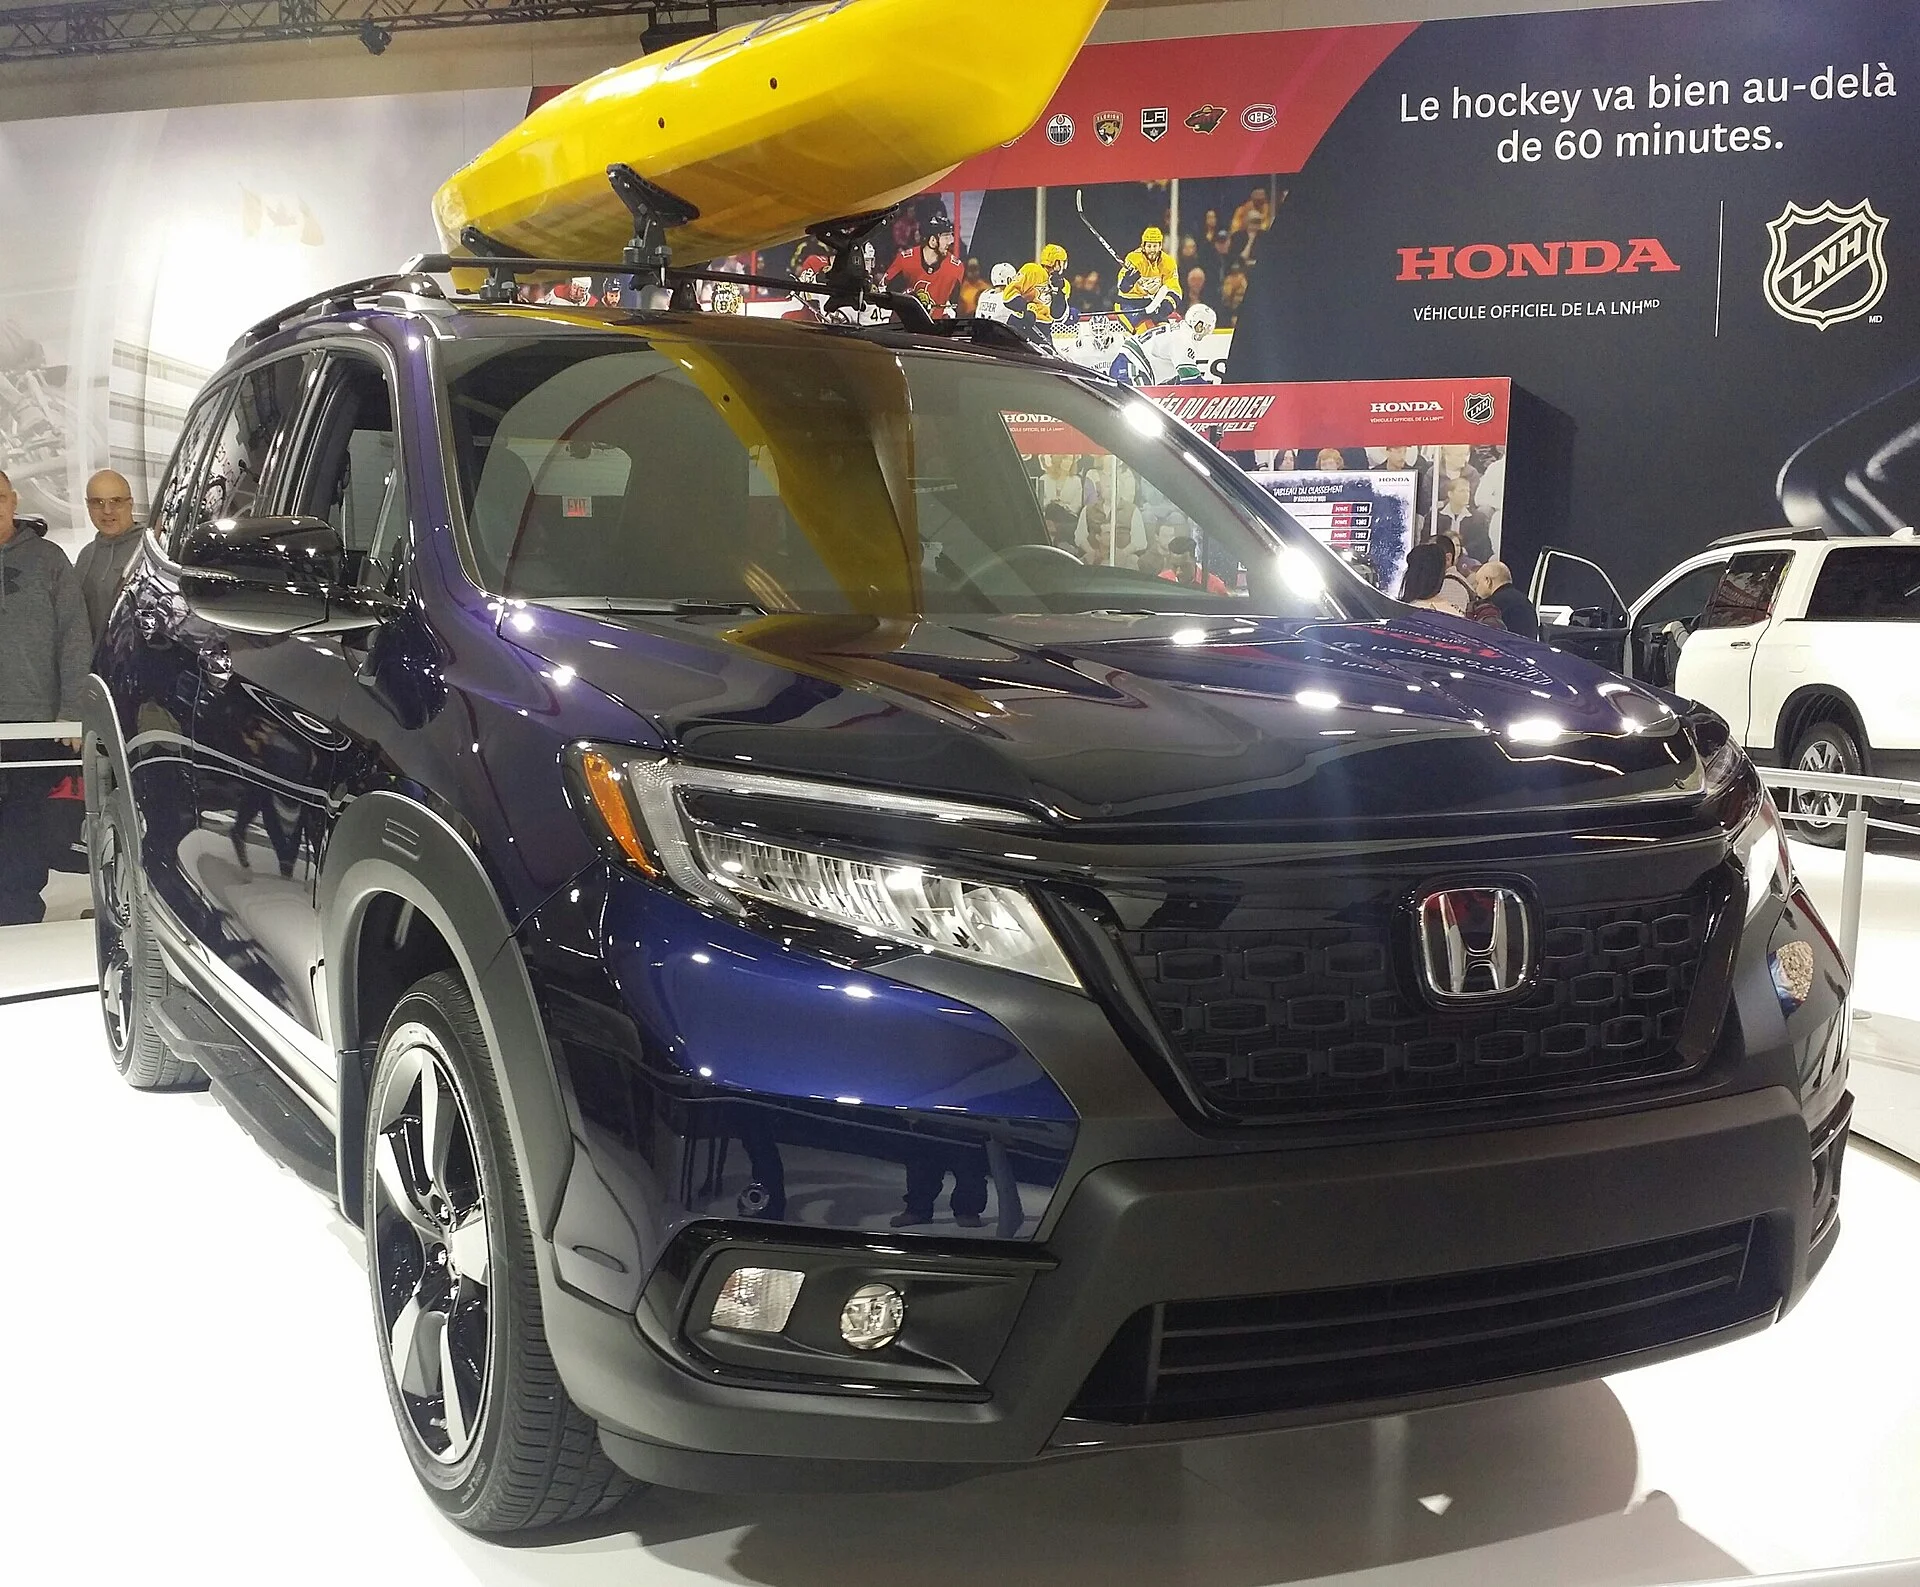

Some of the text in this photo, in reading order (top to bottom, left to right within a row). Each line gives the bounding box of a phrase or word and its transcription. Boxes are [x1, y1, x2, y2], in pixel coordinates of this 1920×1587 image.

[1400, 62, 1897, 123] Le hockey va bien au-delà
[1496, 121, 1784, 163] de 60 minutes.
[1395, 238, 1681, 281] HONDA
[1791, 226, 1862, 301] LNH
[1413, 304, 1486, 321] VÉHICULE
[1490, 302, 1557, 319] OFFICIEL
[1562, 303, 1582, 316] DE
[1586, 302, 1606, 316] LA
[1200, 396, 1276, 419] GARDIEN
[1370, 401, 1444, 413] HONDA
[1470, 399, 1489, 418] LNH
